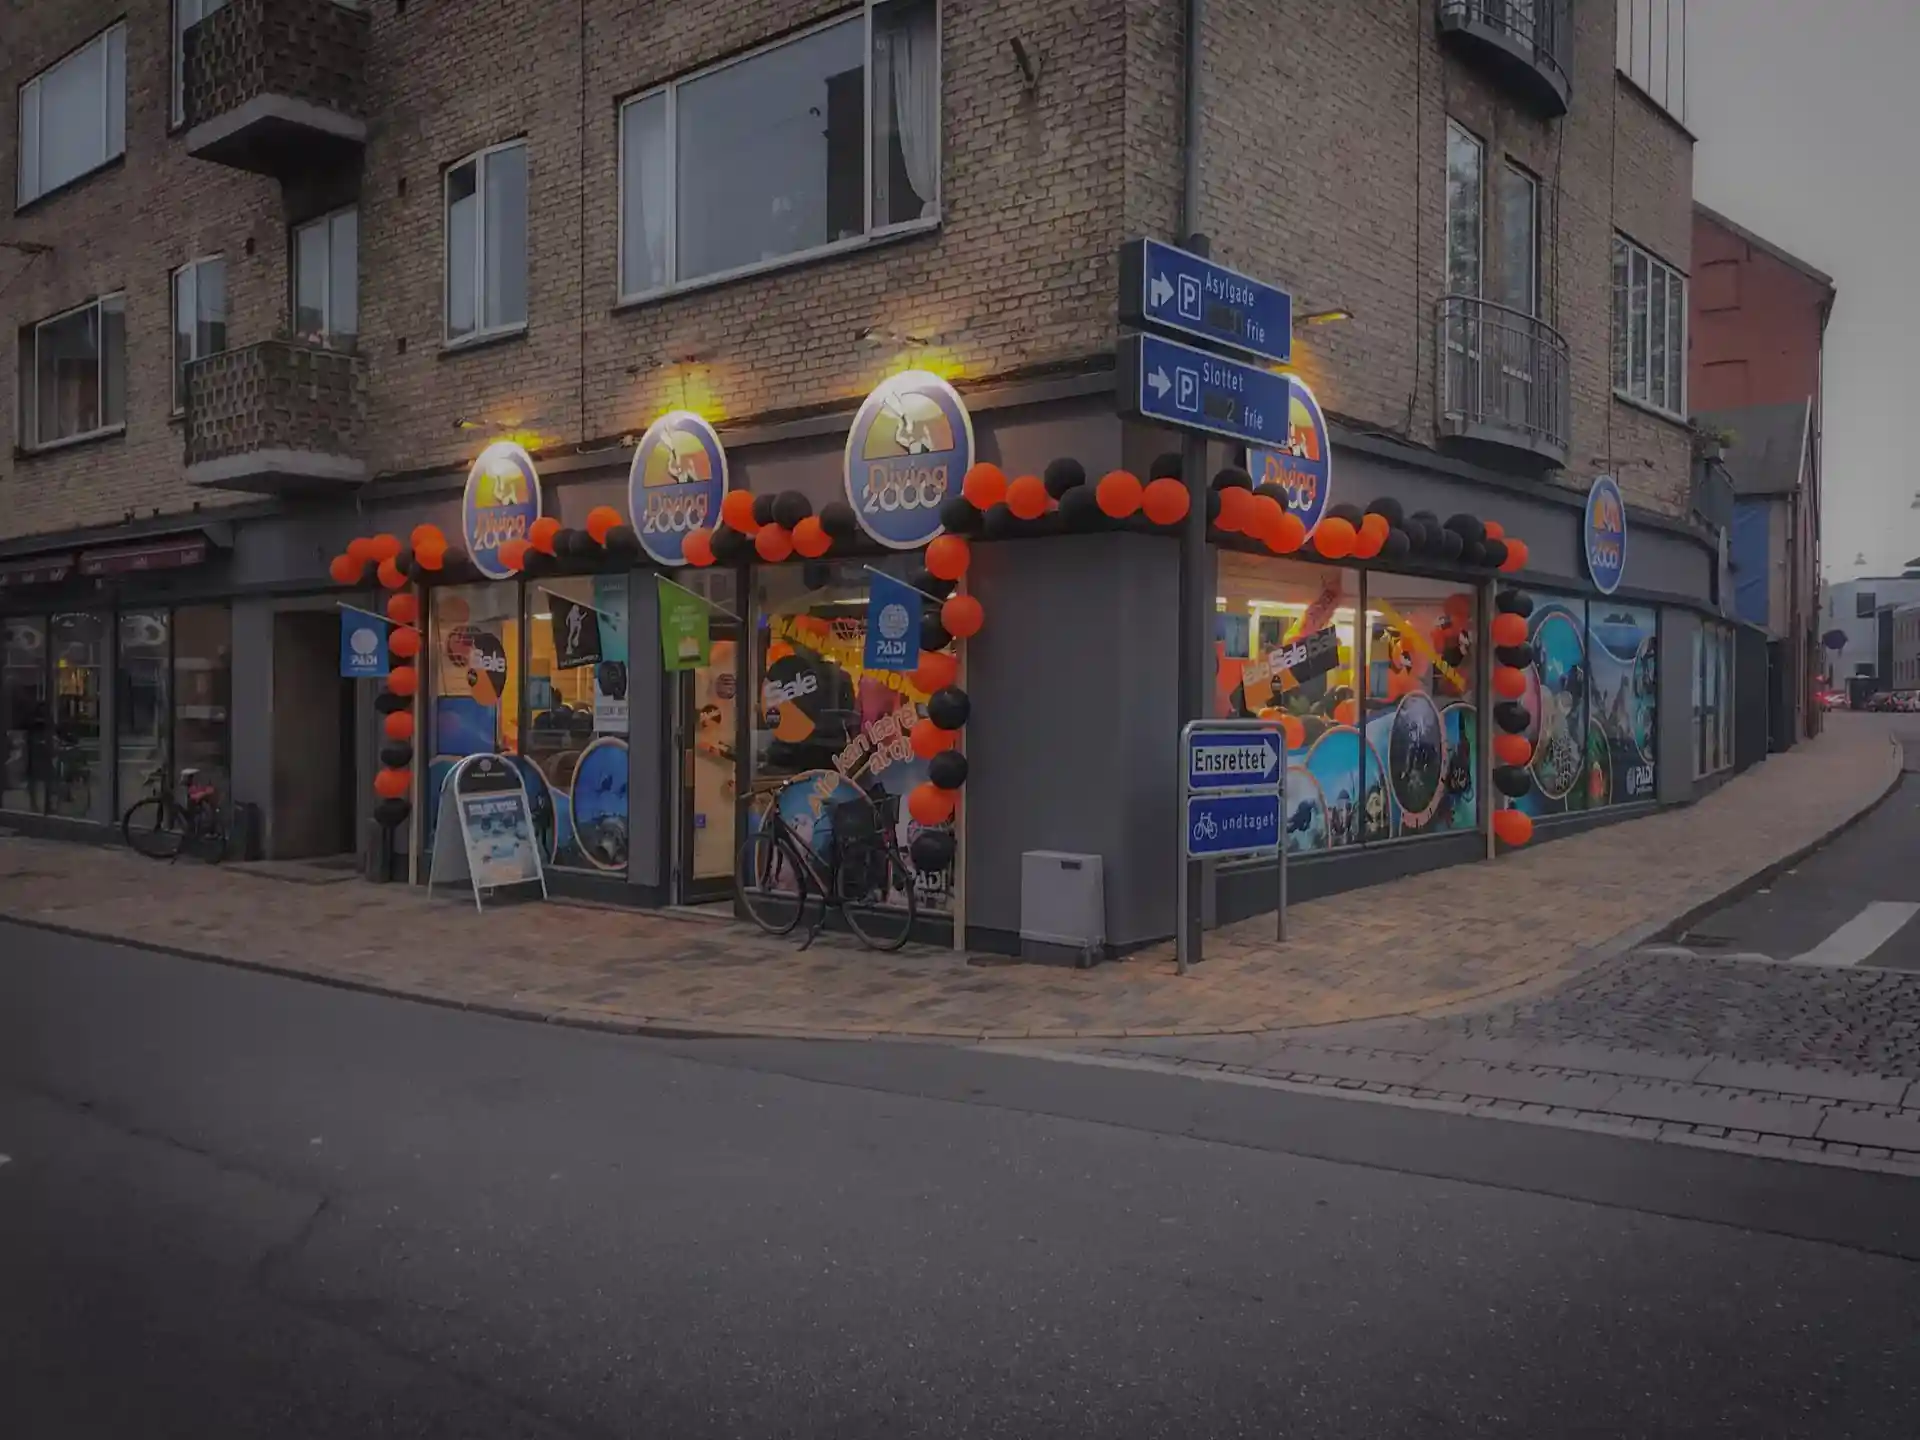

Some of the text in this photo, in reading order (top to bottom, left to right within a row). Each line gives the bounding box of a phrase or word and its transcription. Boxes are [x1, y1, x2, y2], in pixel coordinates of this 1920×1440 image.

[1205, 270, 1255, 307] Asylgade
[1246, 318, 1265, 342] frie
[1203, 362, 1243, 392] Slottet
[1244, 407, 1263, 430] frie
[869, 461, 948, 494] Diving
[1265, 455, 1318, 499] Diving
[648, 488, 708, 518] Diving
[476, 511, 525, 537] Diving
[876, 640, 907, 656] PADI
[1195, 748, 1266, 771] Ensrettet
[1222, 812, 1274, 831] undtaget
